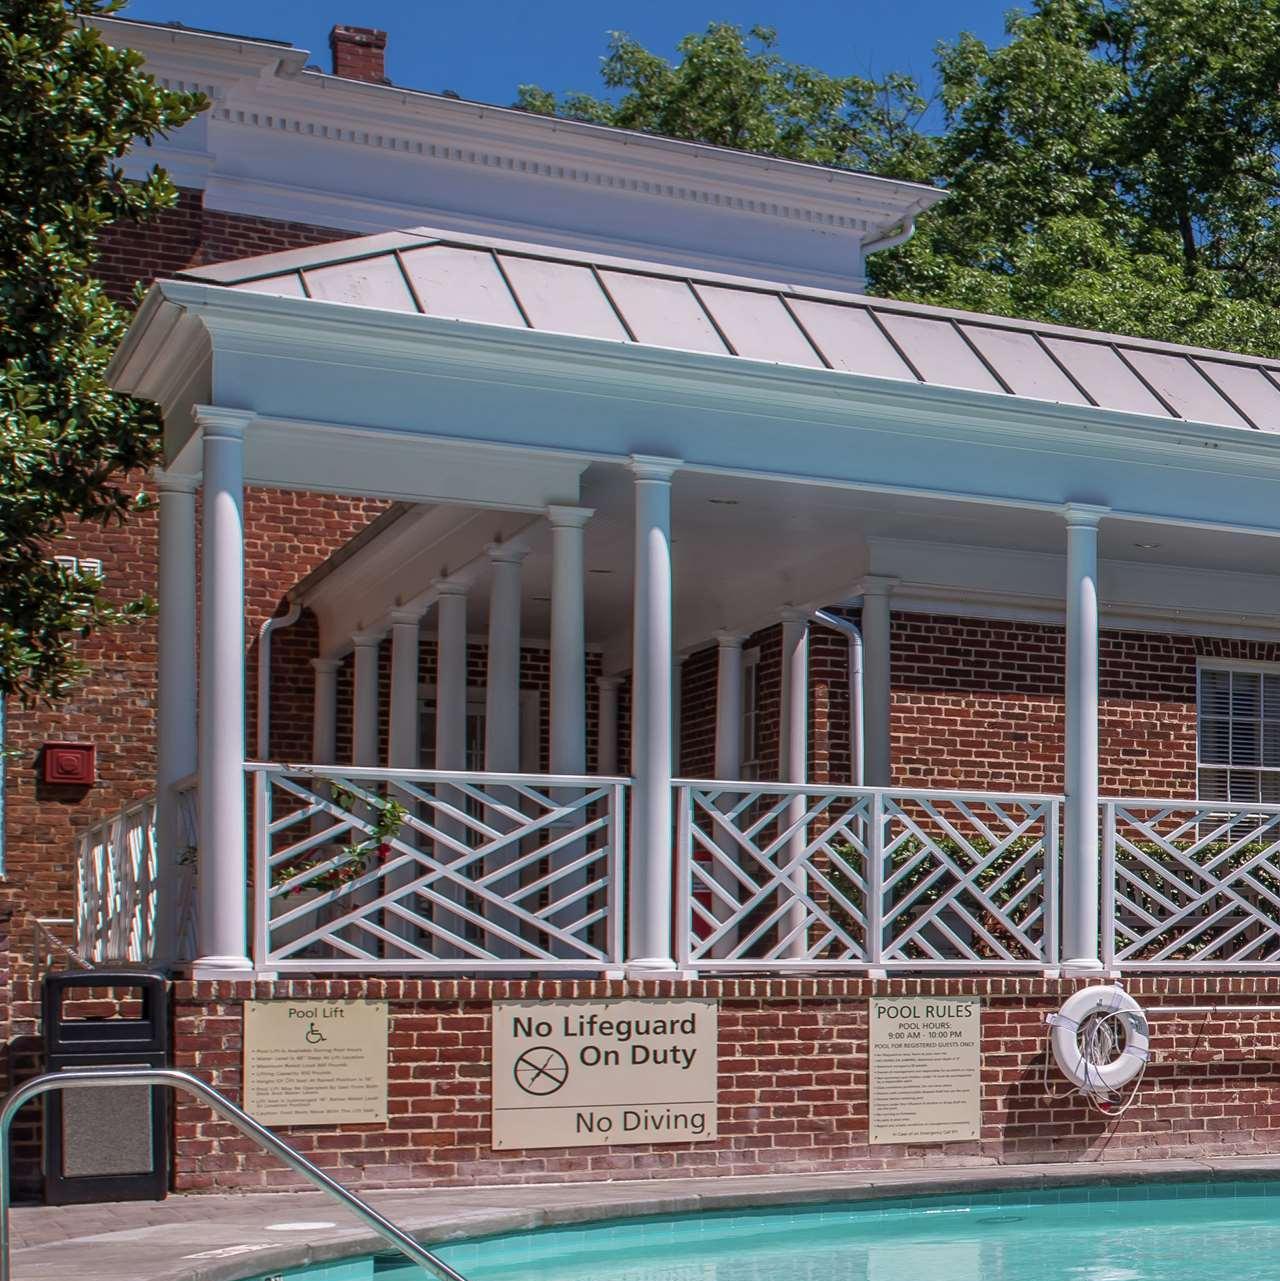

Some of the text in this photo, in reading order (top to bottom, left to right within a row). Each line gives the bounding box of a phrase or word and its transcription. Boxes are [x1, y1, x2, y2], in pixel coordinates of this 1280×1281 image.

[288, 1007, 345, 1018] Pool Lift
[877, 1004, 972, 1019] POOL RULES
[513, 1013, 696, 1042] No Lifeguard
[922, 1022, 952, 1030] HOURS:
[907, 1031, 920, 1039] AM
[580, 1044, 697, 1070] On Duty
[576, 1109, 706, 1135] No Diving
